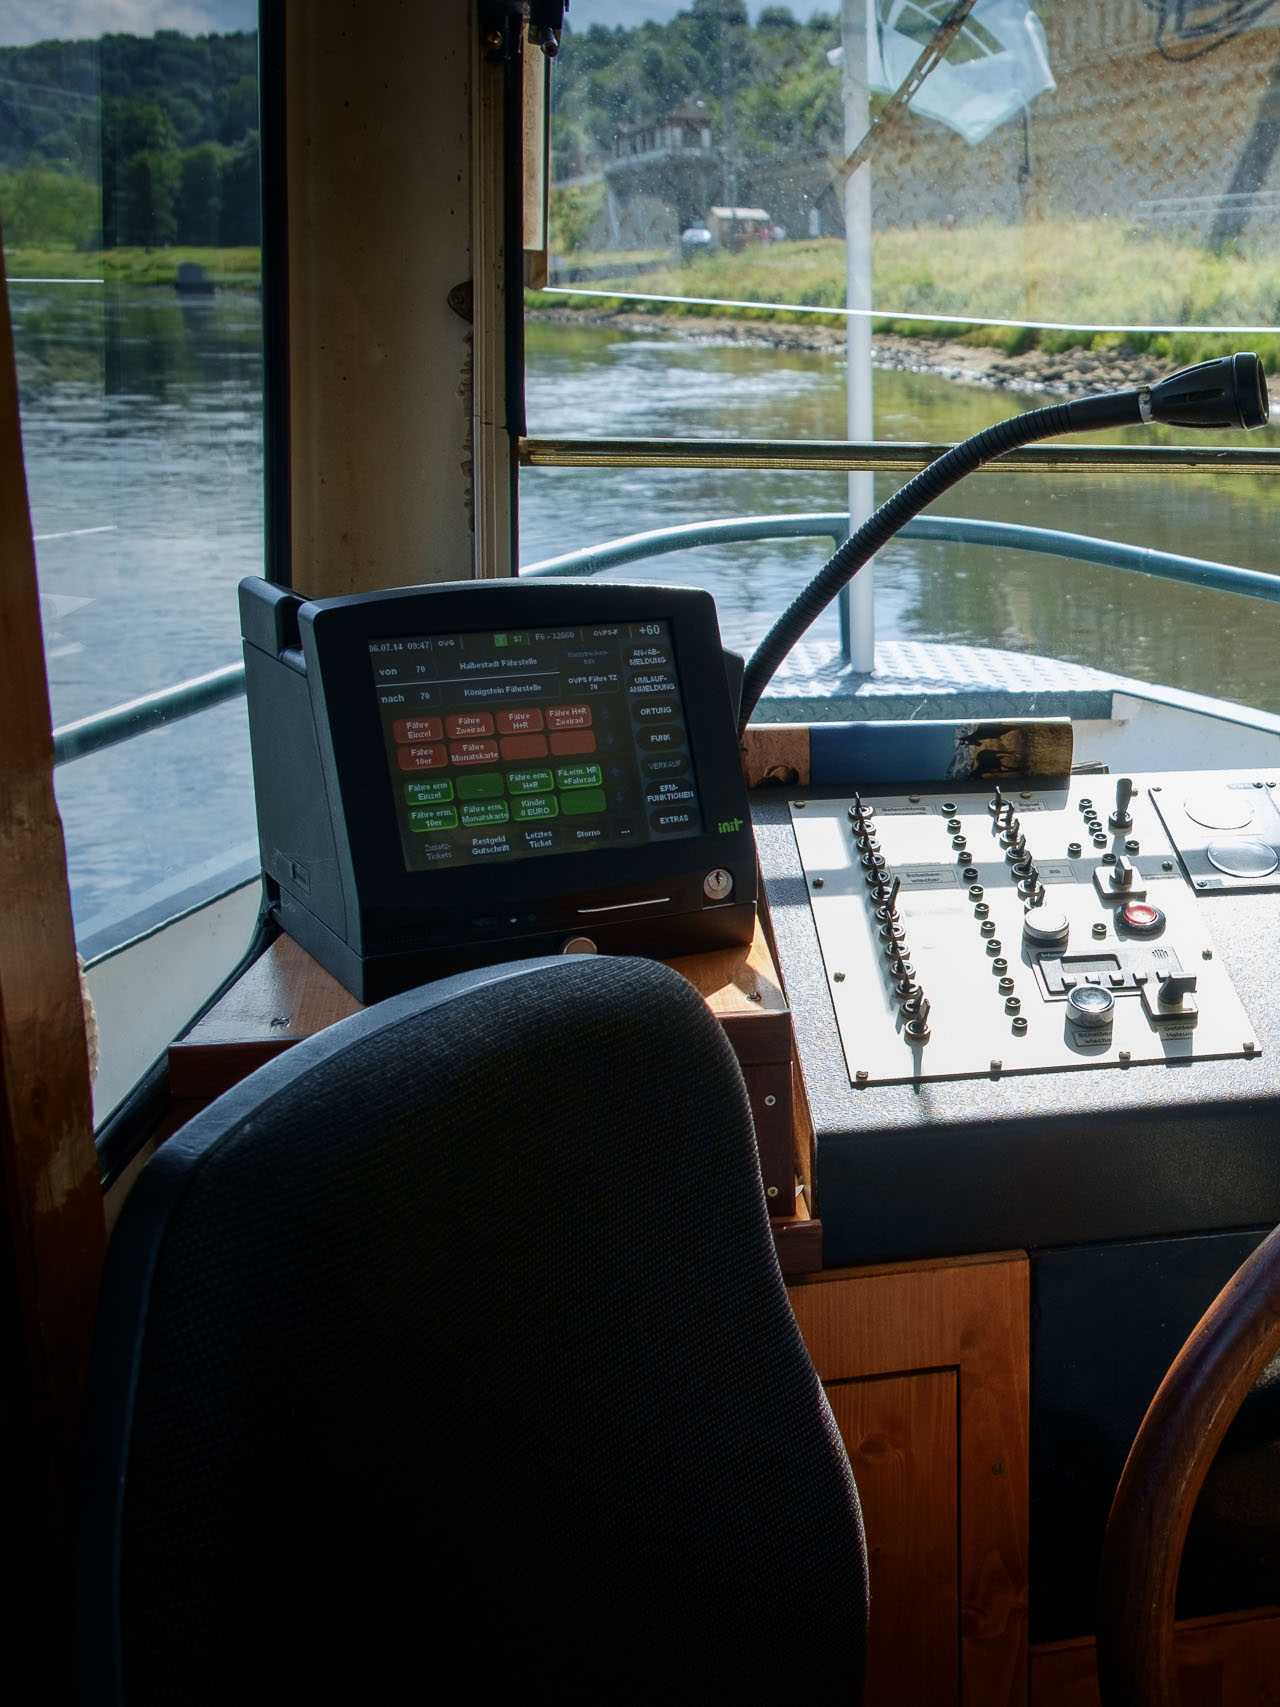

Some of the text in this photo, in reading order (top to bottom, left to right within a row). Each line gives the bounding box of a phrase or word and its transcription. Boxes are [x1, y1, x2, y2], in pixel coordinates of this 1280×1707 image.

[639, 624, 661, 636] +60
[629, 656, 667, 667] MELDUNG
[379, 667, 398, 677] von
[629, 683, 676, 693] ANMELDUNG
[381, 693, 405, 704] nach
[464, 686, 505, 699] Königstein
[508, 712, 530, 720] Fähre
[549, 708, 570, 717] Fähre
[640, 707, 672, 716] ORTUNG
[407, 721, 429, 729] Fähre
[458, 717, 481, 725] Fähre
[555, 717, 584, 727] Zweirad
[408, 730, 432, 739] Einzel
[456, 725, 486, 735] Zweirad
[650, 734, 671, 743] FUNK
[462, 743, 485, 752] Fähre
[411, 748, 434, 757] Fähre
[451, 751, 499, 762] Monatskarte
[415, 758, 432, 766] 10er
[509, 774, 531, 782] Fähre
[408, 783, 431, 792] Fähre
[418, 792, 442, 800] Einzel
[647, 791, 694, 803] FUNKTIONEN
[521, 799, 546, 808] Kinder
[463, 805, 486, 814] Fähre
[527, 807, 550, 816] EURO
[411, 811, 435, 820] Fähre
[659, 814, 690, 825] EXTRAS
[525, 830, 553, 840] Letztes
[576, 829, 602, 839] Storno
[472, 836, 506, 847] Restgeld
[529, 839, 553, 849] Ticket
[472, 844, 510, 856] Gutschrift
[426, 851, 453, 861] Tickets
